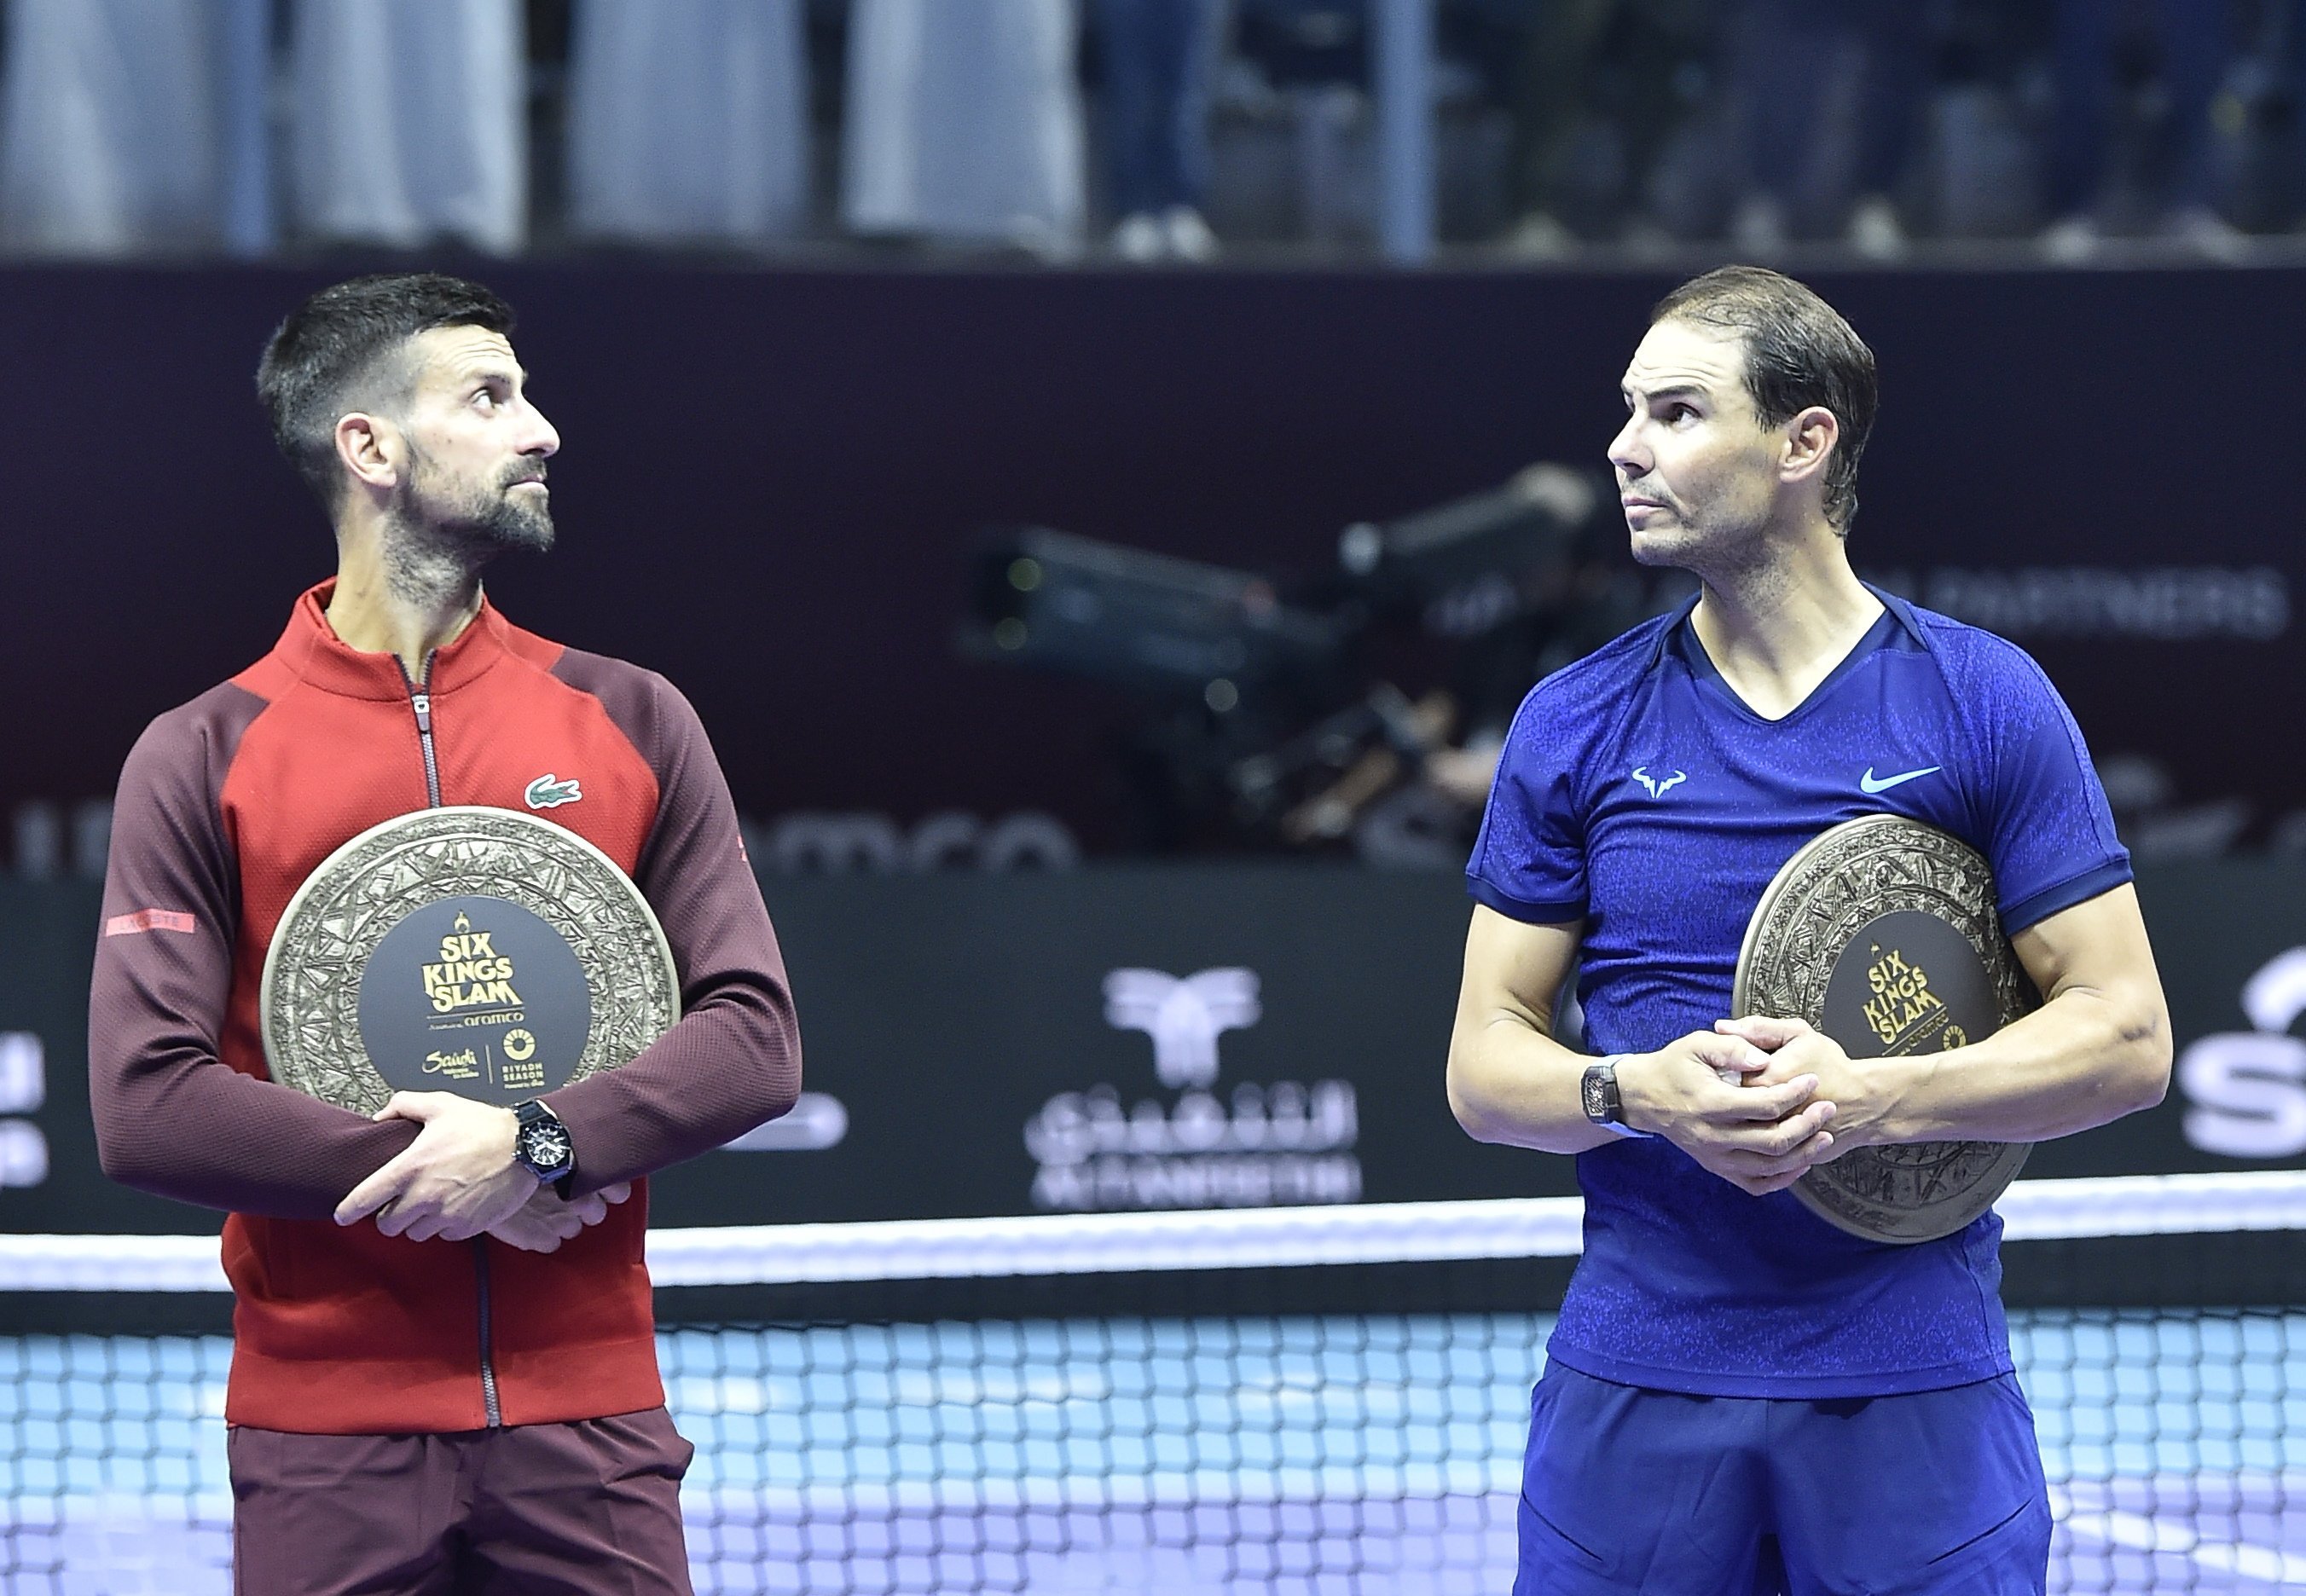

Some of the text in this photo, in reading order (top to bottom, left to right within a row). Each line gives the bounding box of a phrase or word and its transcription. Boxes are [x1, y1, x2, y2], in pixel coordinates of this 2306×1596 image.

[439, 932, 496, 963] SIX
[422, 957, 514, 998] KINGS
[1868, 949, 1910, 993] SIX
[432, 980, 524, 1013] SLAM
[1863, 966, 1928, 1032] KINGS
[464, 1012, 524, 1026] aramco
[1879, 989, 1944, 1044] SLAM
[421, 1048, 478, 1074] Saudi
[501, 1062, 543, 1074] RIYADH
[502, 1071, 545, 1083] SEASON
